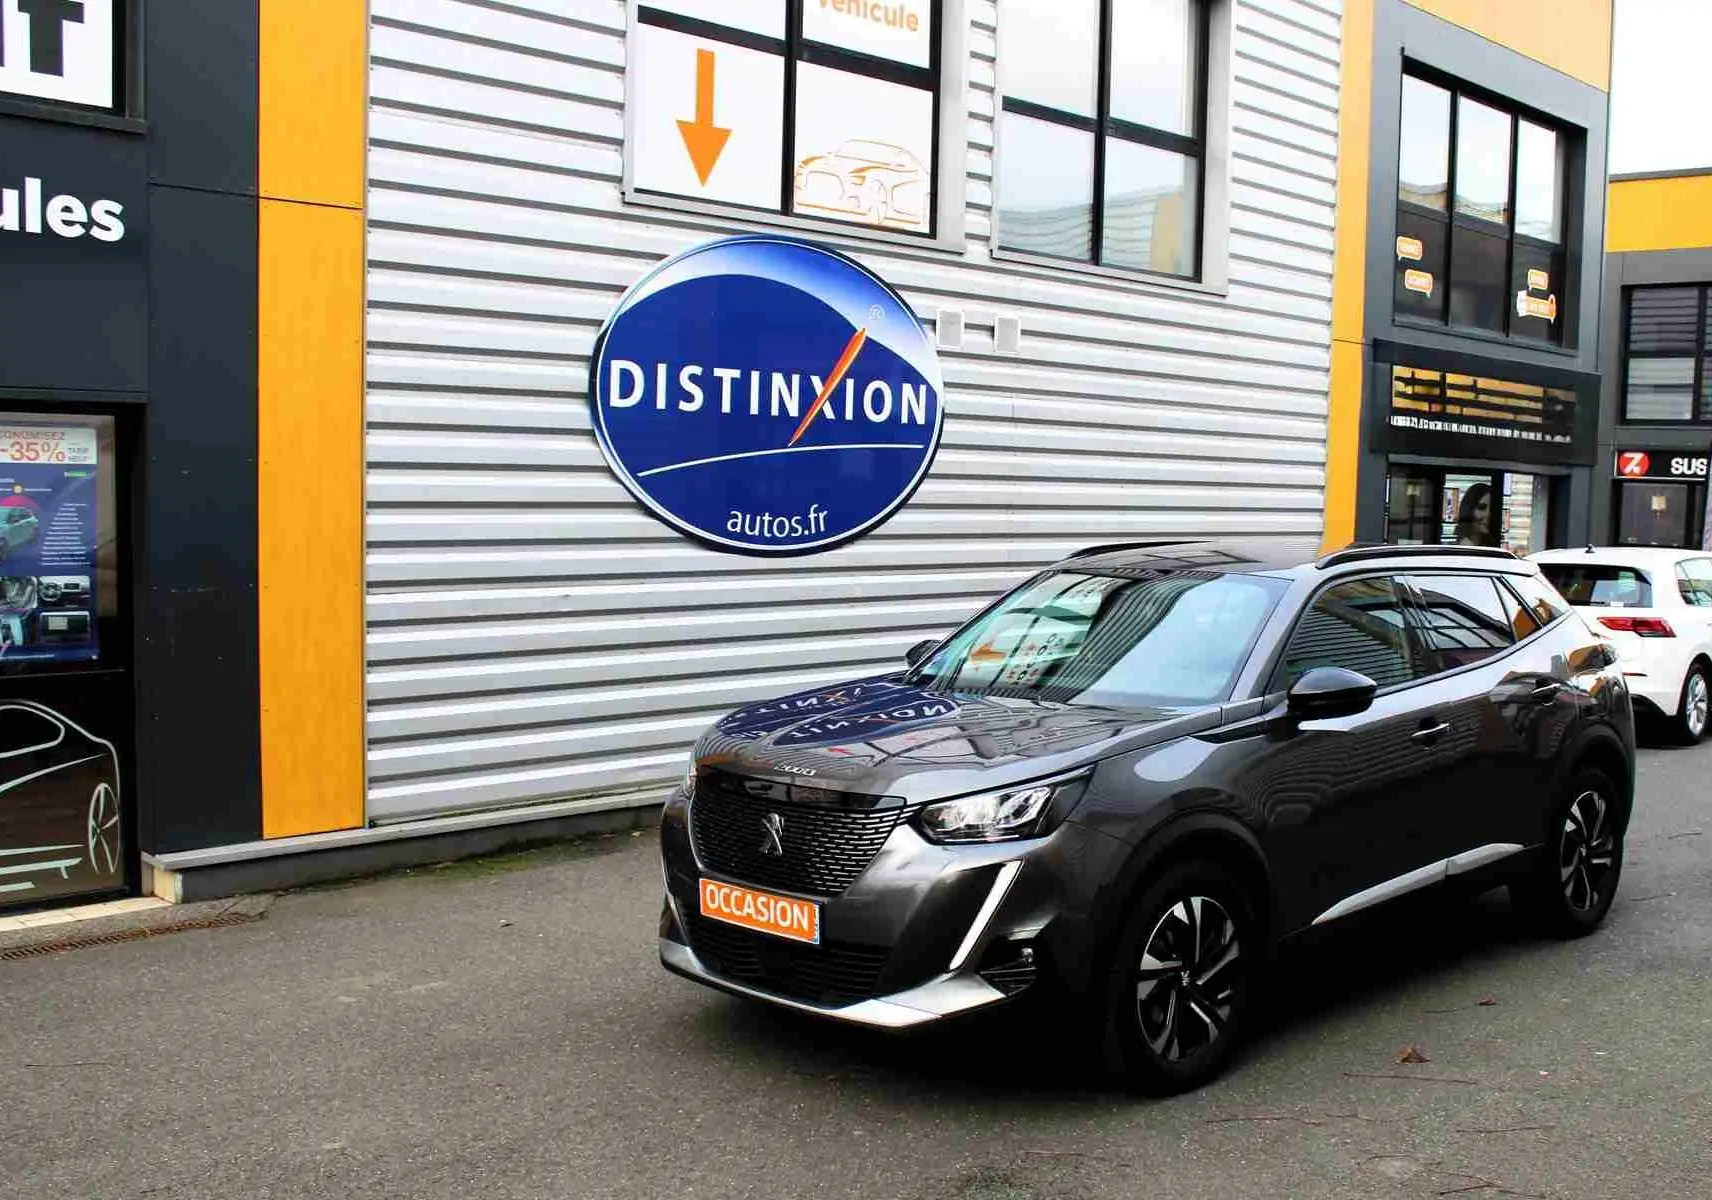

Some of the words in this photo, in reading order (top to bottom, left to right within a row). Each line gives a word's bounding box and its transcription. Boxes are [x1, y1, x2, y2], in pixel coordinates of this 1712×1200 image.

[608, 358, 927, 426] DISTINXION
[0, 440, 67, 462] -35%
[726, 503, 829, 537] autos.fr
[705, 884, 809, 932] OCCASION
